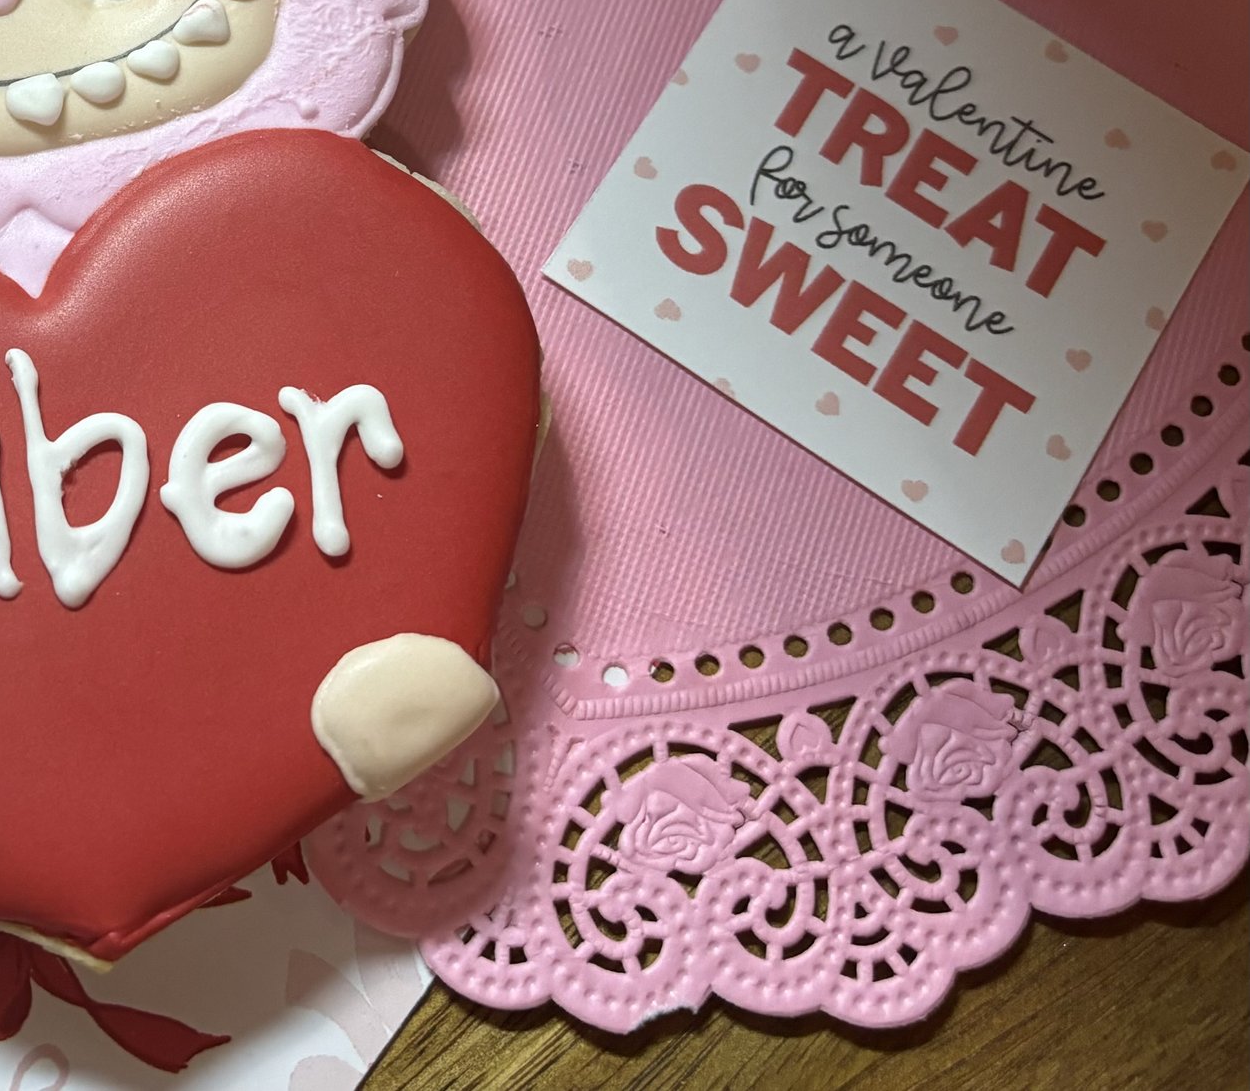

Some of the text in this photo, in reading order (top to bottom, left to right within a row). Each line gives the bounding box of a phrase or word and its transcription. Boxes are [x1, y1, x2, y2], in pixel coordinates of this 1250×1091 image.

[828, 23, 865, 60] a
[750, 145, 1014, 335] for someone
[774, 48, 1107, 299] TREAT
[656, 184, 1036, 456] SWEET
